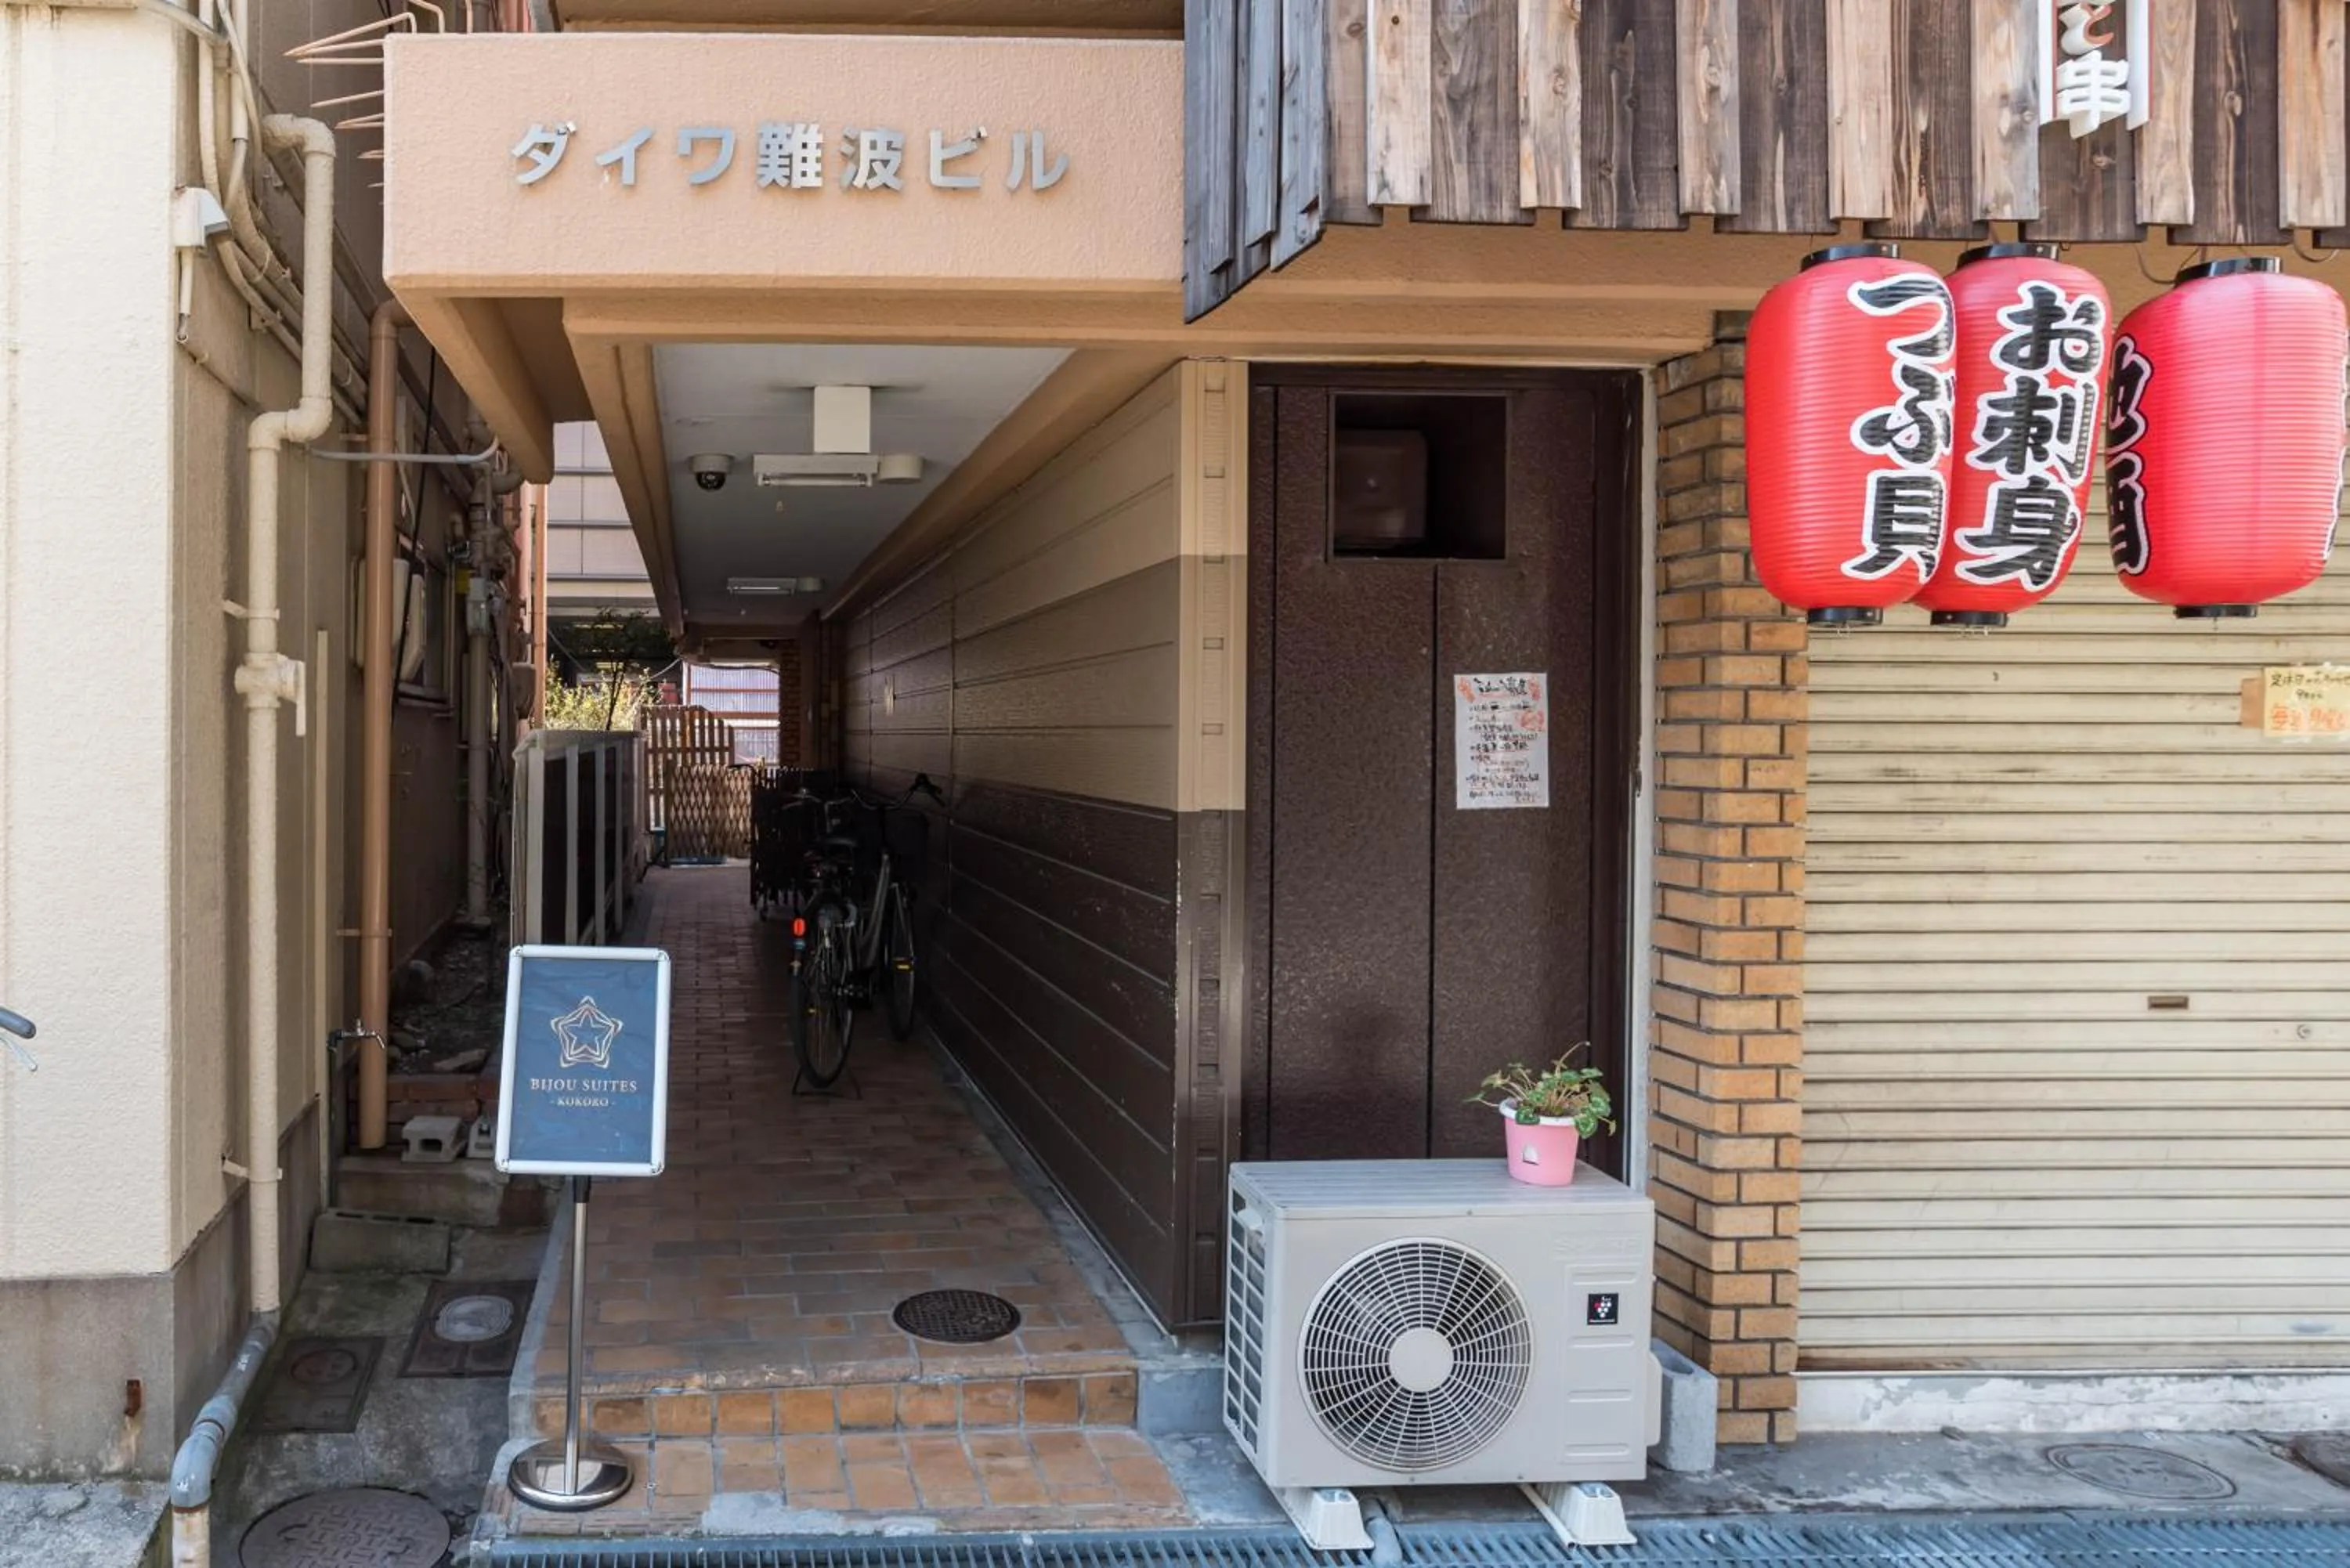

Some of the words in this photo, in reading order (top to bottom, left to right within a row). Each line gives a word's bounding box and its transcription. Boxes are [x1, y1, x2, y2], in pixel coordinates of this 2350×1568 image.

[2055, 0, 2131, 139] と串
[510, 120, 1071, 190] ダイワ難波ビル
[1841, 272, 1957, 584] つぶ貝
[1955, 279, 2106, 591] お刺身
[530, 1077, 577, 1092] BIJOU
[582, 1078, 638, 1093] SUITES
